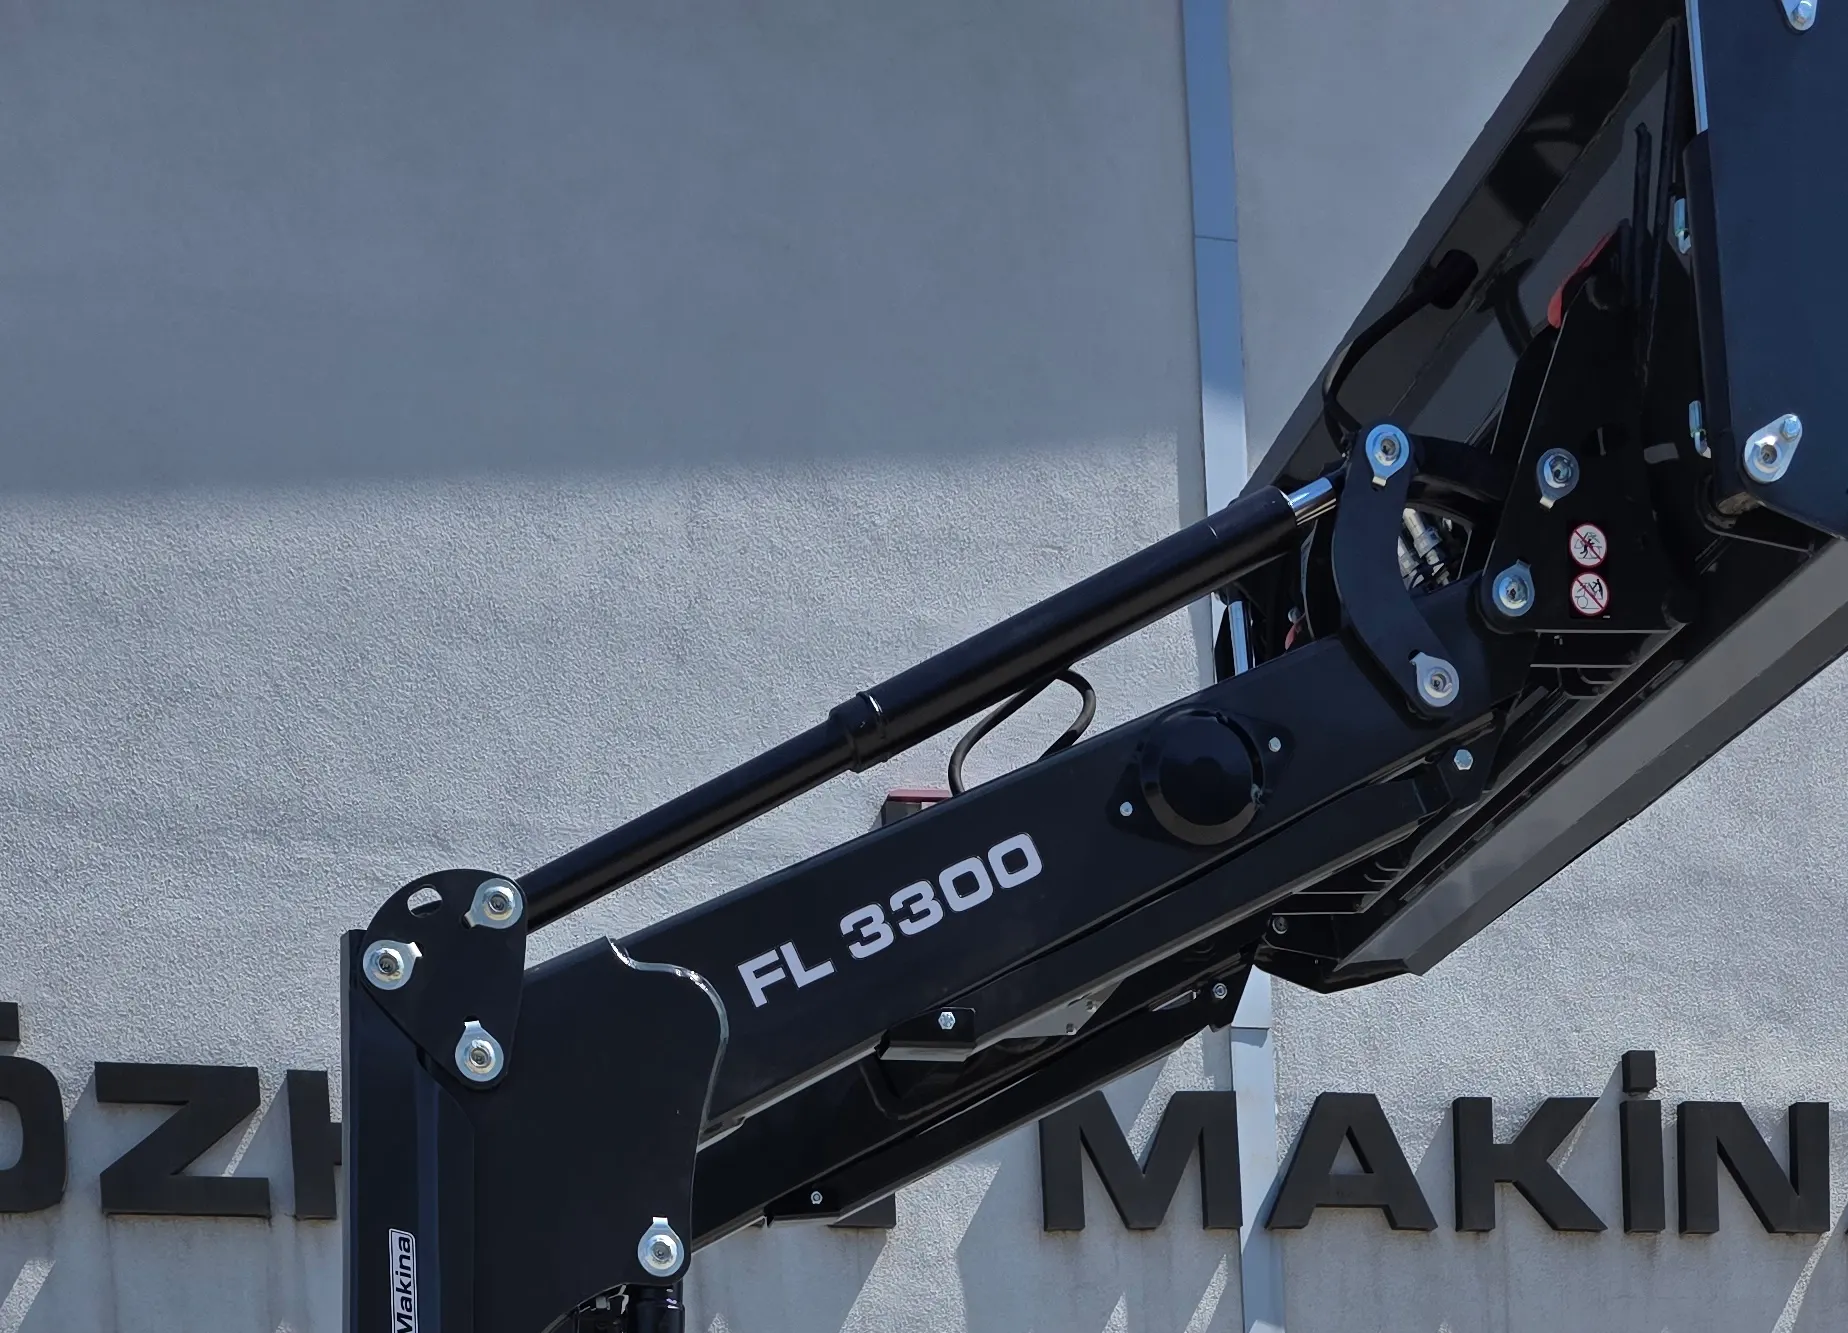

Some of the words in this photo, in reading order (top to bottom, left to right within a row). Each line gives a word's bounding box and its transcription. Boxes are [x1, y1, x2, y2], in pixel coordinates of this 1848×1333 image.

[737, 940, 837, 1008] FL
[839, 832, 1044, 961] 3300
[1038, 1049, 1848, 1233] MAKİN
